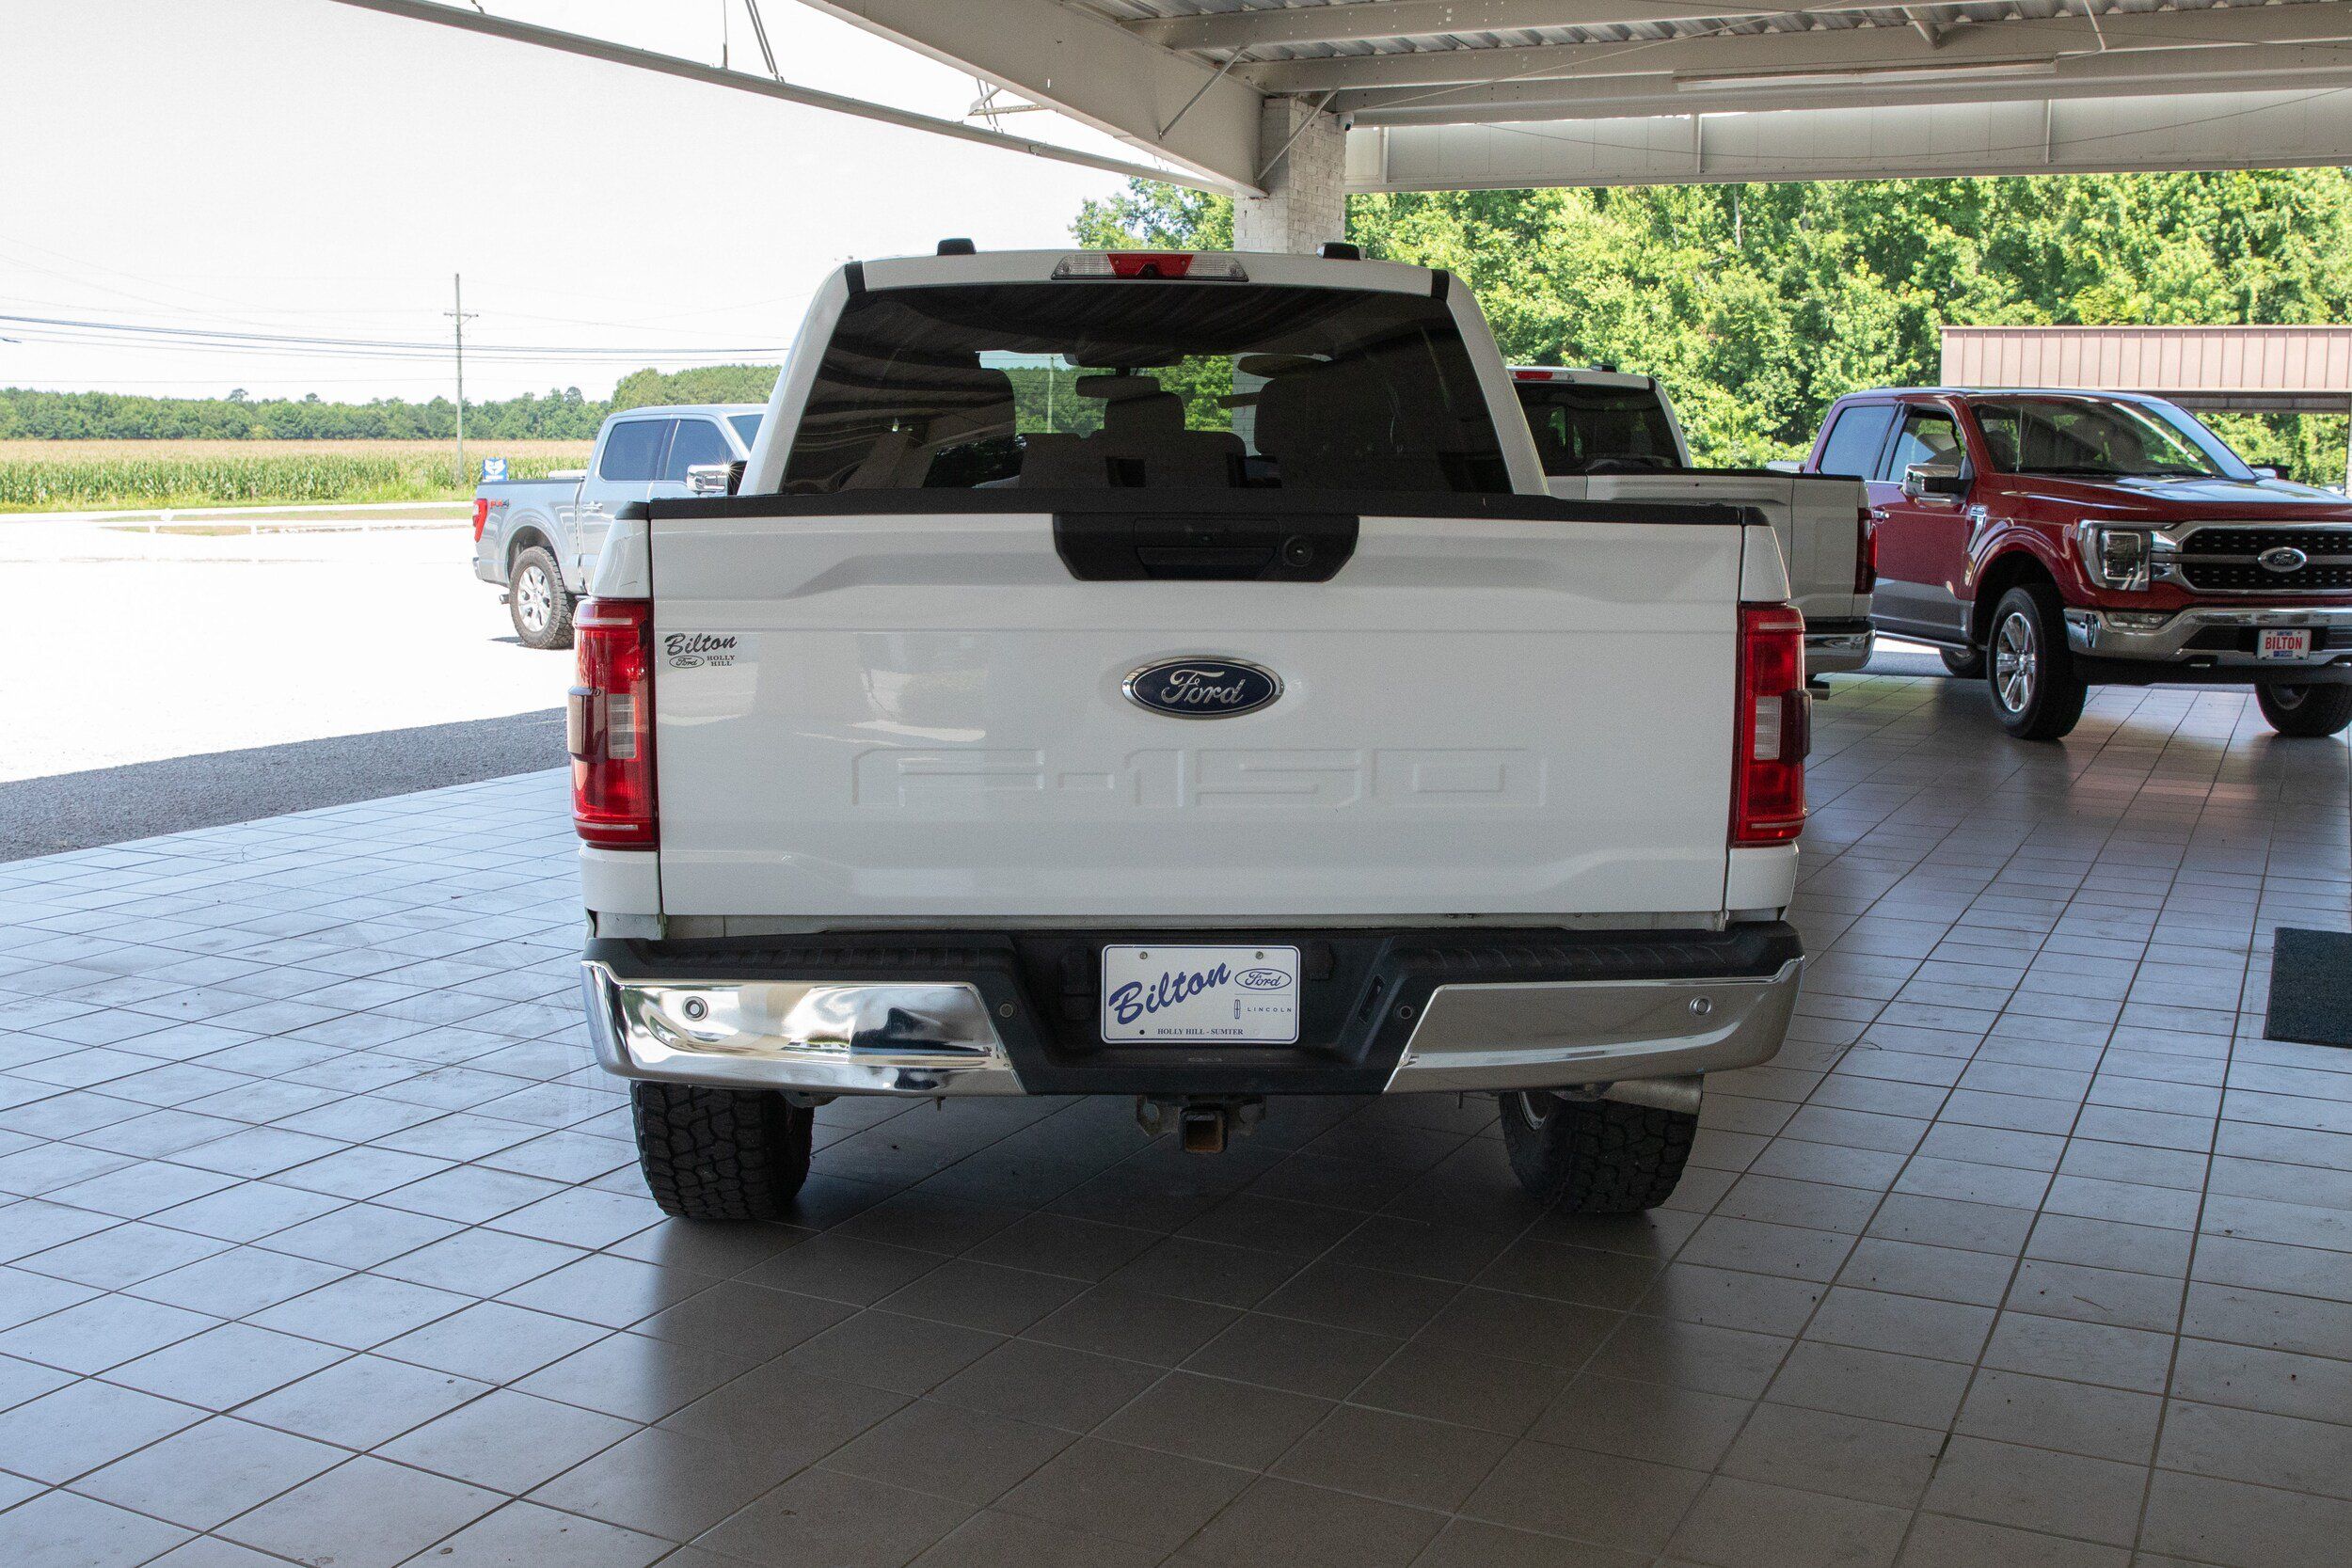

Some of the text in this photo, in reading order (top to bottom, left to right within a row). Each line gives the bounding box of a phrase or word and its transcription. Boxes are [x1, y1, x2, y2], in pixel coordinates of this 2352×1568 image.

[664, 633, 737, 656] Bilton
[2265, 637, 2302, 649] BILTON
[676, 657, 698, 666] Ford
[1161, 669, 1246, 704] Ford
[852, 747, 1549, 808] F-150
[1245, 971, 1280, 987] Ford
[1108, 962, 1231, 1025] Bilton
